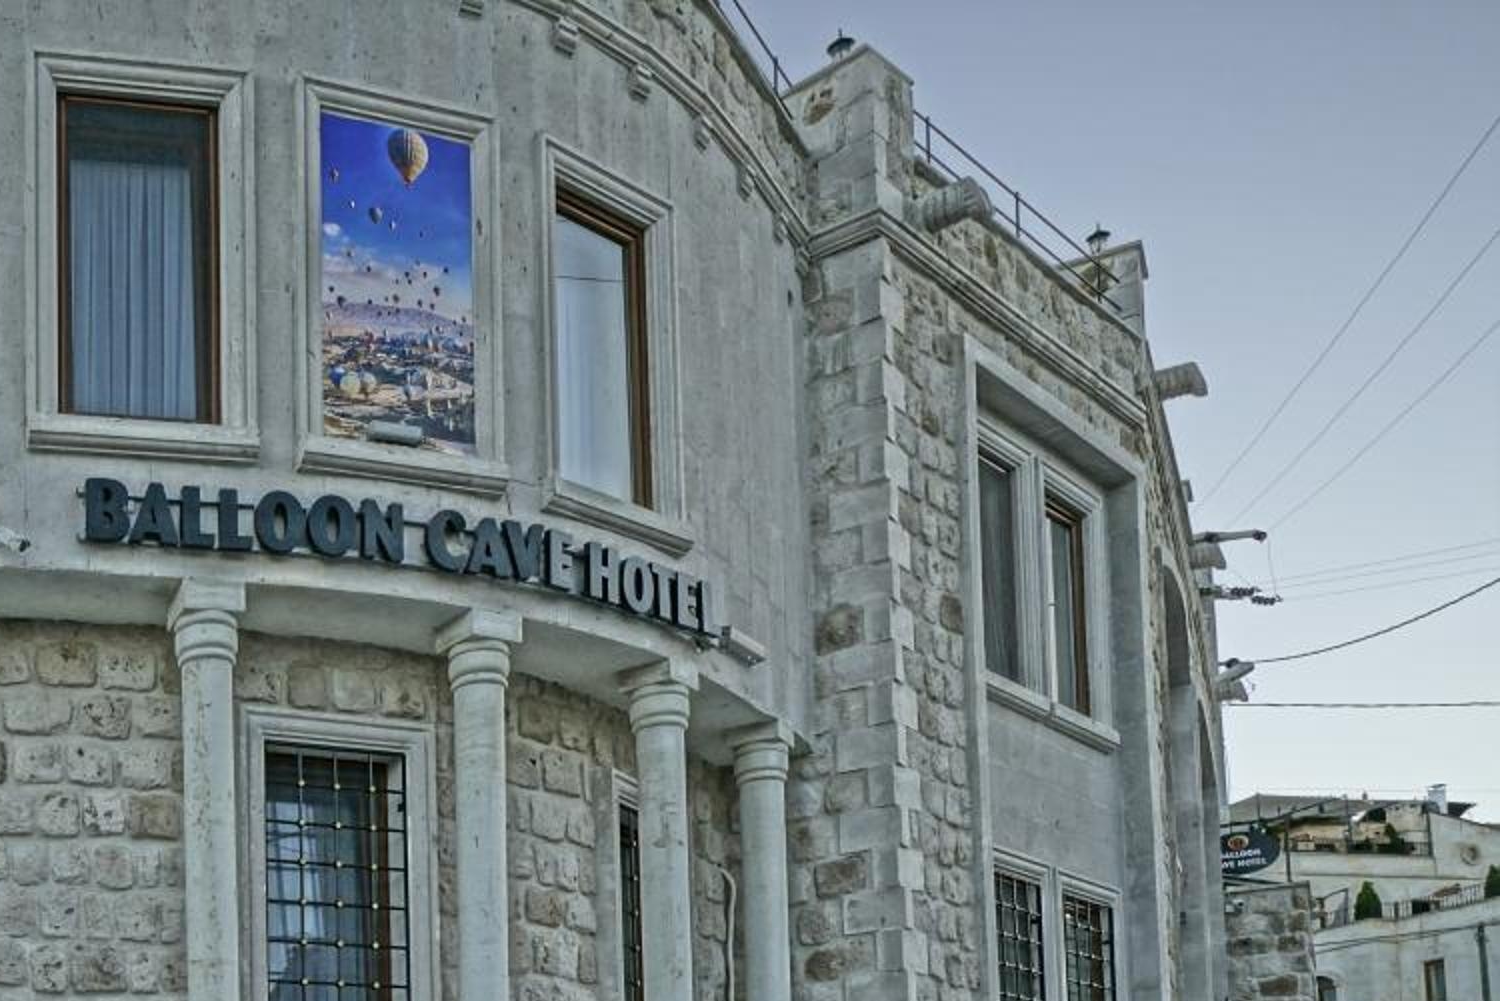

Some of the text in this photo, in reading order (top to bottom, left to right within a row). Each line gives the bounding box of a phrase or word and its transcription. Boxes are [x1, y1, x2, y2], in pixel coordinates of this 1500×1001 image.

[85, 477, 724, 639] BALLOON CAVE HOTEL
